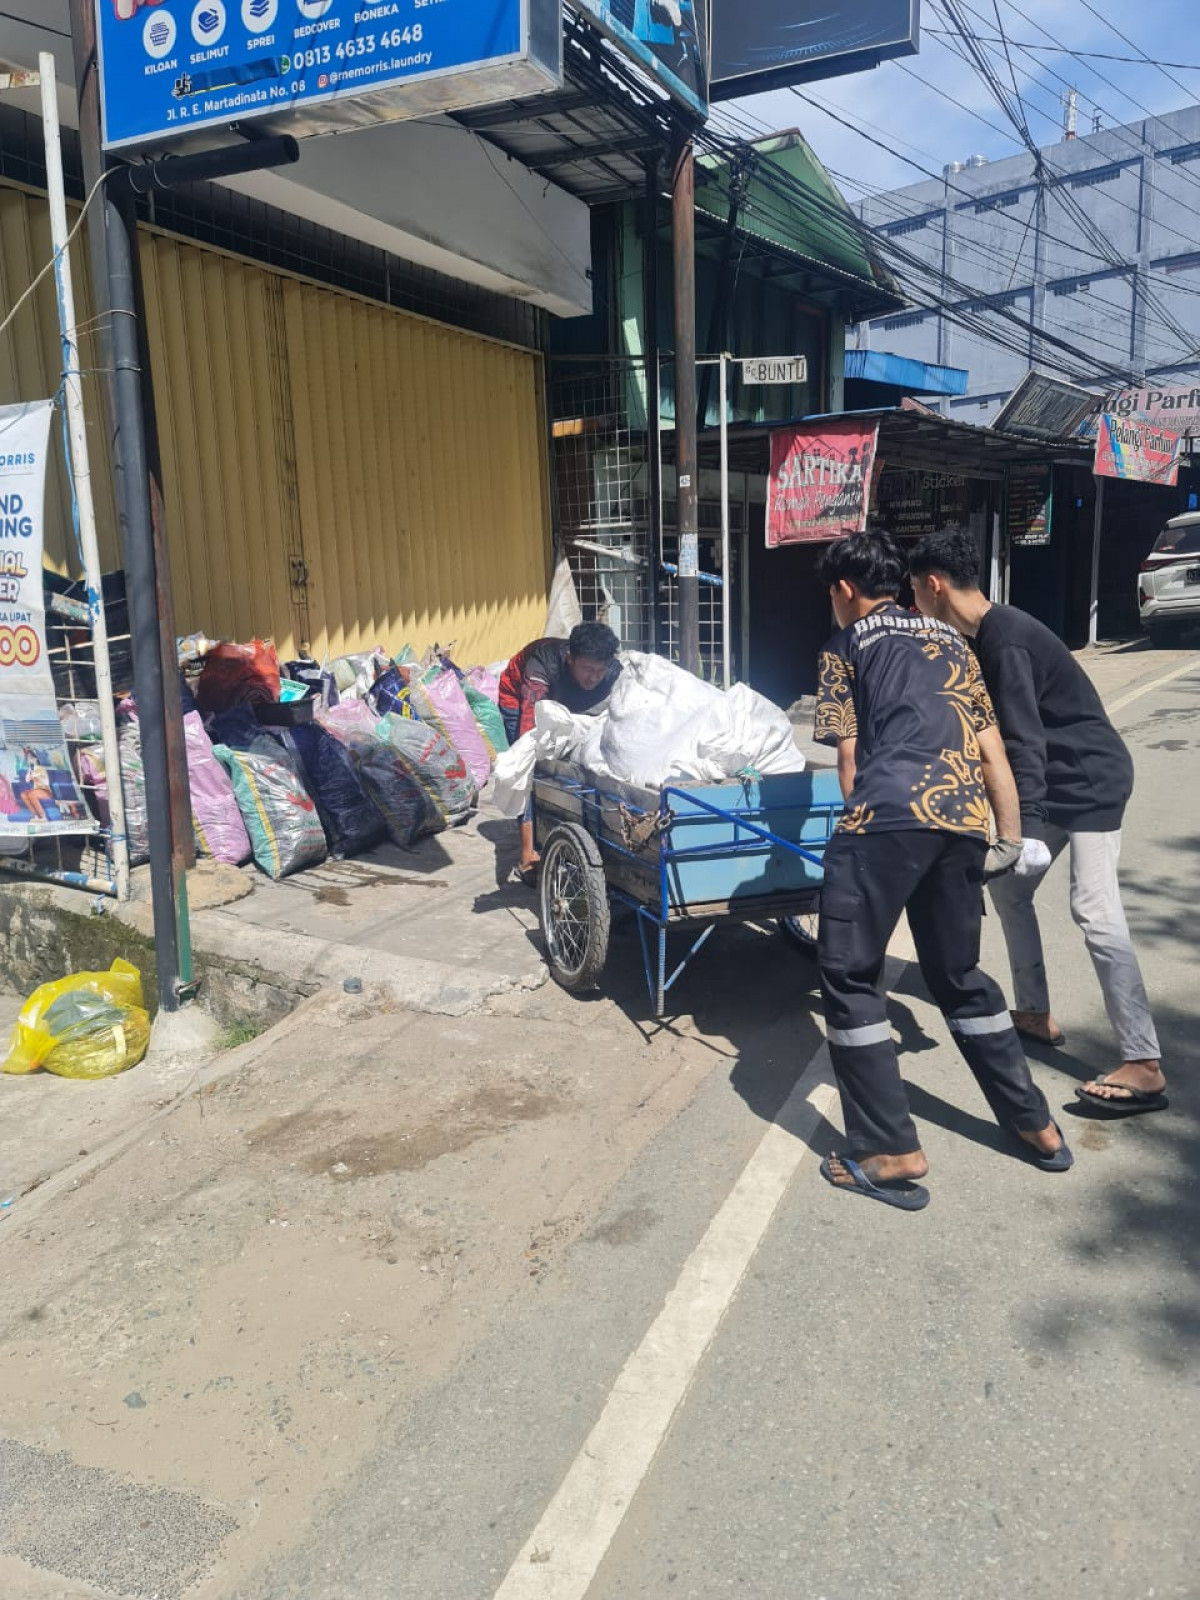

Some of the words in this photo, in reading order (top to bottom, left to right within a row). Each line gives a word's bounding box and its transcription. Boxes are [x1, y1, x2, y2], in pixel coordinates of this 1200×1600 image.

[354, 3, 399, 23] BONEKA
[293, 18, 341, 39] BEDCOVER
[246, 34, 275, 50] SPREI
[294, 45, 331, 70] 0813
[335, 34, 376, 60] 4633
[380, 23, 423, 49] 4648
[190, 45, 230, 64] SELIMUT
[144, 59, 178, 75] KILOAN
[329, 51, 433, 84] @memorris.laundry
[166, 109, 178, 121] Jl.
[180, 107, 190, 119] R.
[192, 104, 202, 116] E.
[204, 88, 267, 113] Martadinata
[269, 85, 289, 98] No.
[291, 79, 306, 93] 08
[758, 360, 805, 381] BUNTU
[1109, 419, 1143, 452] Pelangi
[776, 453, 863, 490] SARTIKA
